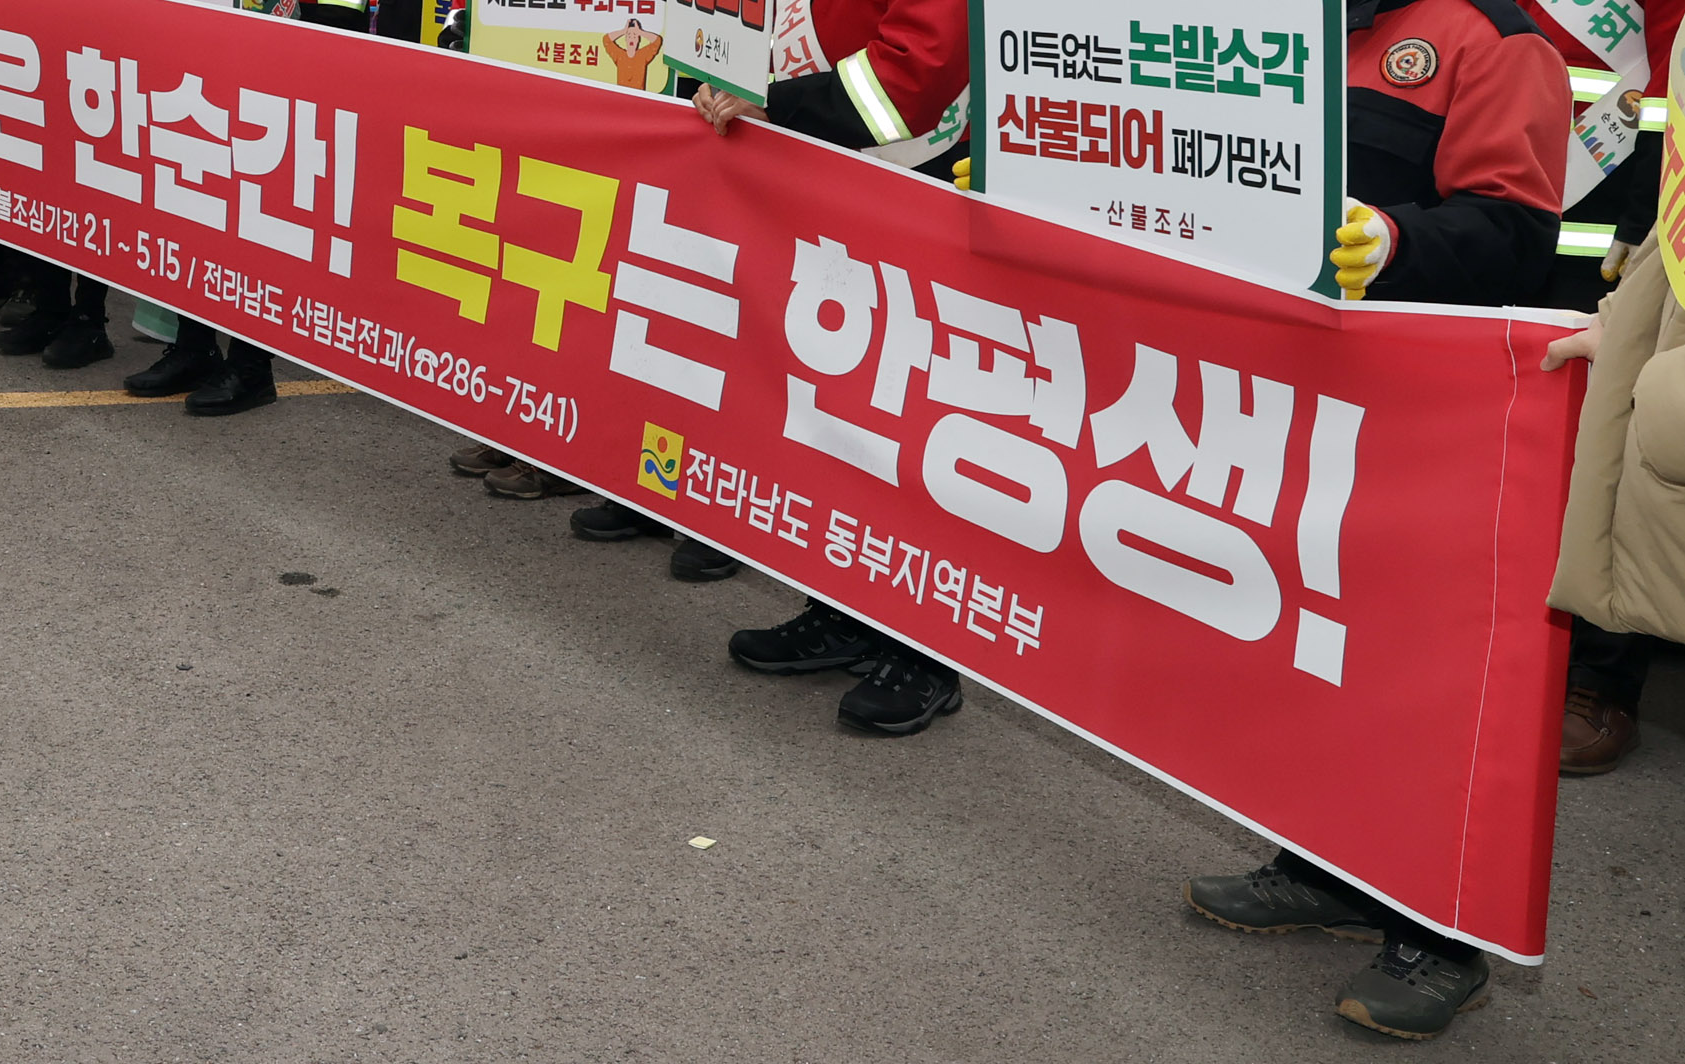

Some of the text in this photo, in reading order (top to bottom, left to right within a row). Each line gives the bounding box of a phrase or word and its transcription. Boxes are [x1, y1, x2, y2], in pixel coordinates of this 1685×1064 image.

[536, 41, 599, 66] 산불조심
[705, 33, 730, 65] 순천시
[1000, 29, 1123, 84] 이득없는
[998, 93, 1163, 174] 산불되어
[1171, 128, 1302, 195] 폐가망신
[1601, 112, 1626, 144] 순천시
[84, 212, 111, 256] 2.1
[136, 230, 181, 281] 5.15
[203, 260, 284, 325] 전라남도
[66, 45, 358, 279] 한순간!
[392, 125, 740, 412] 복구는
[782, 234, 1366, 688] 한평생!
[685, 447, 1045, 656] 전라남도 동부지역본부
